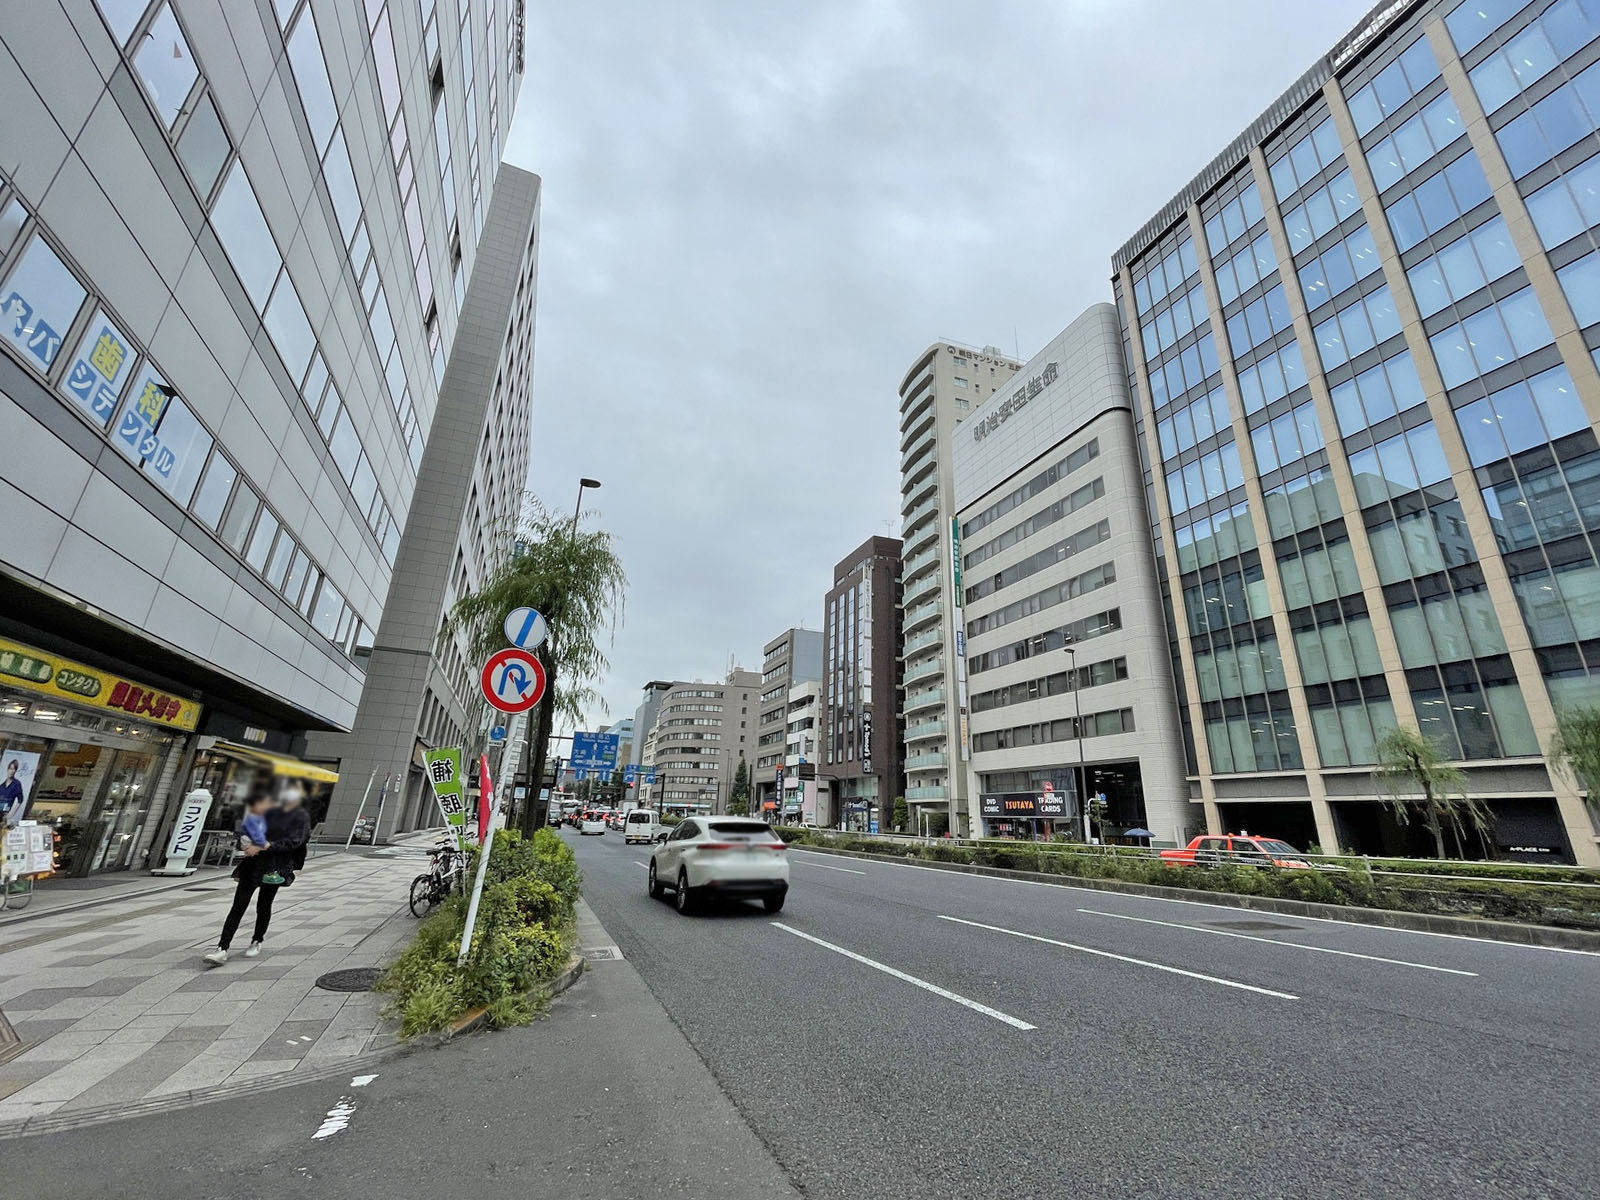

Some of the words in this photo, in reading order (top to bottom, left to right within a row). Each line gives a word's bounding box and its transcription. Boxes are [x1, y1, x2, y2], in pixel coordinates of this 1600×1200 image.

[92, 334, 166, 425] 歯科
[973, 361, 1058, 442] 明治安田生命
[58, 671, 99, 693] コンタクト
[1005, 800, 1034, 810] TSUTAYA
[173, 806, 201, 854] コンタクト
